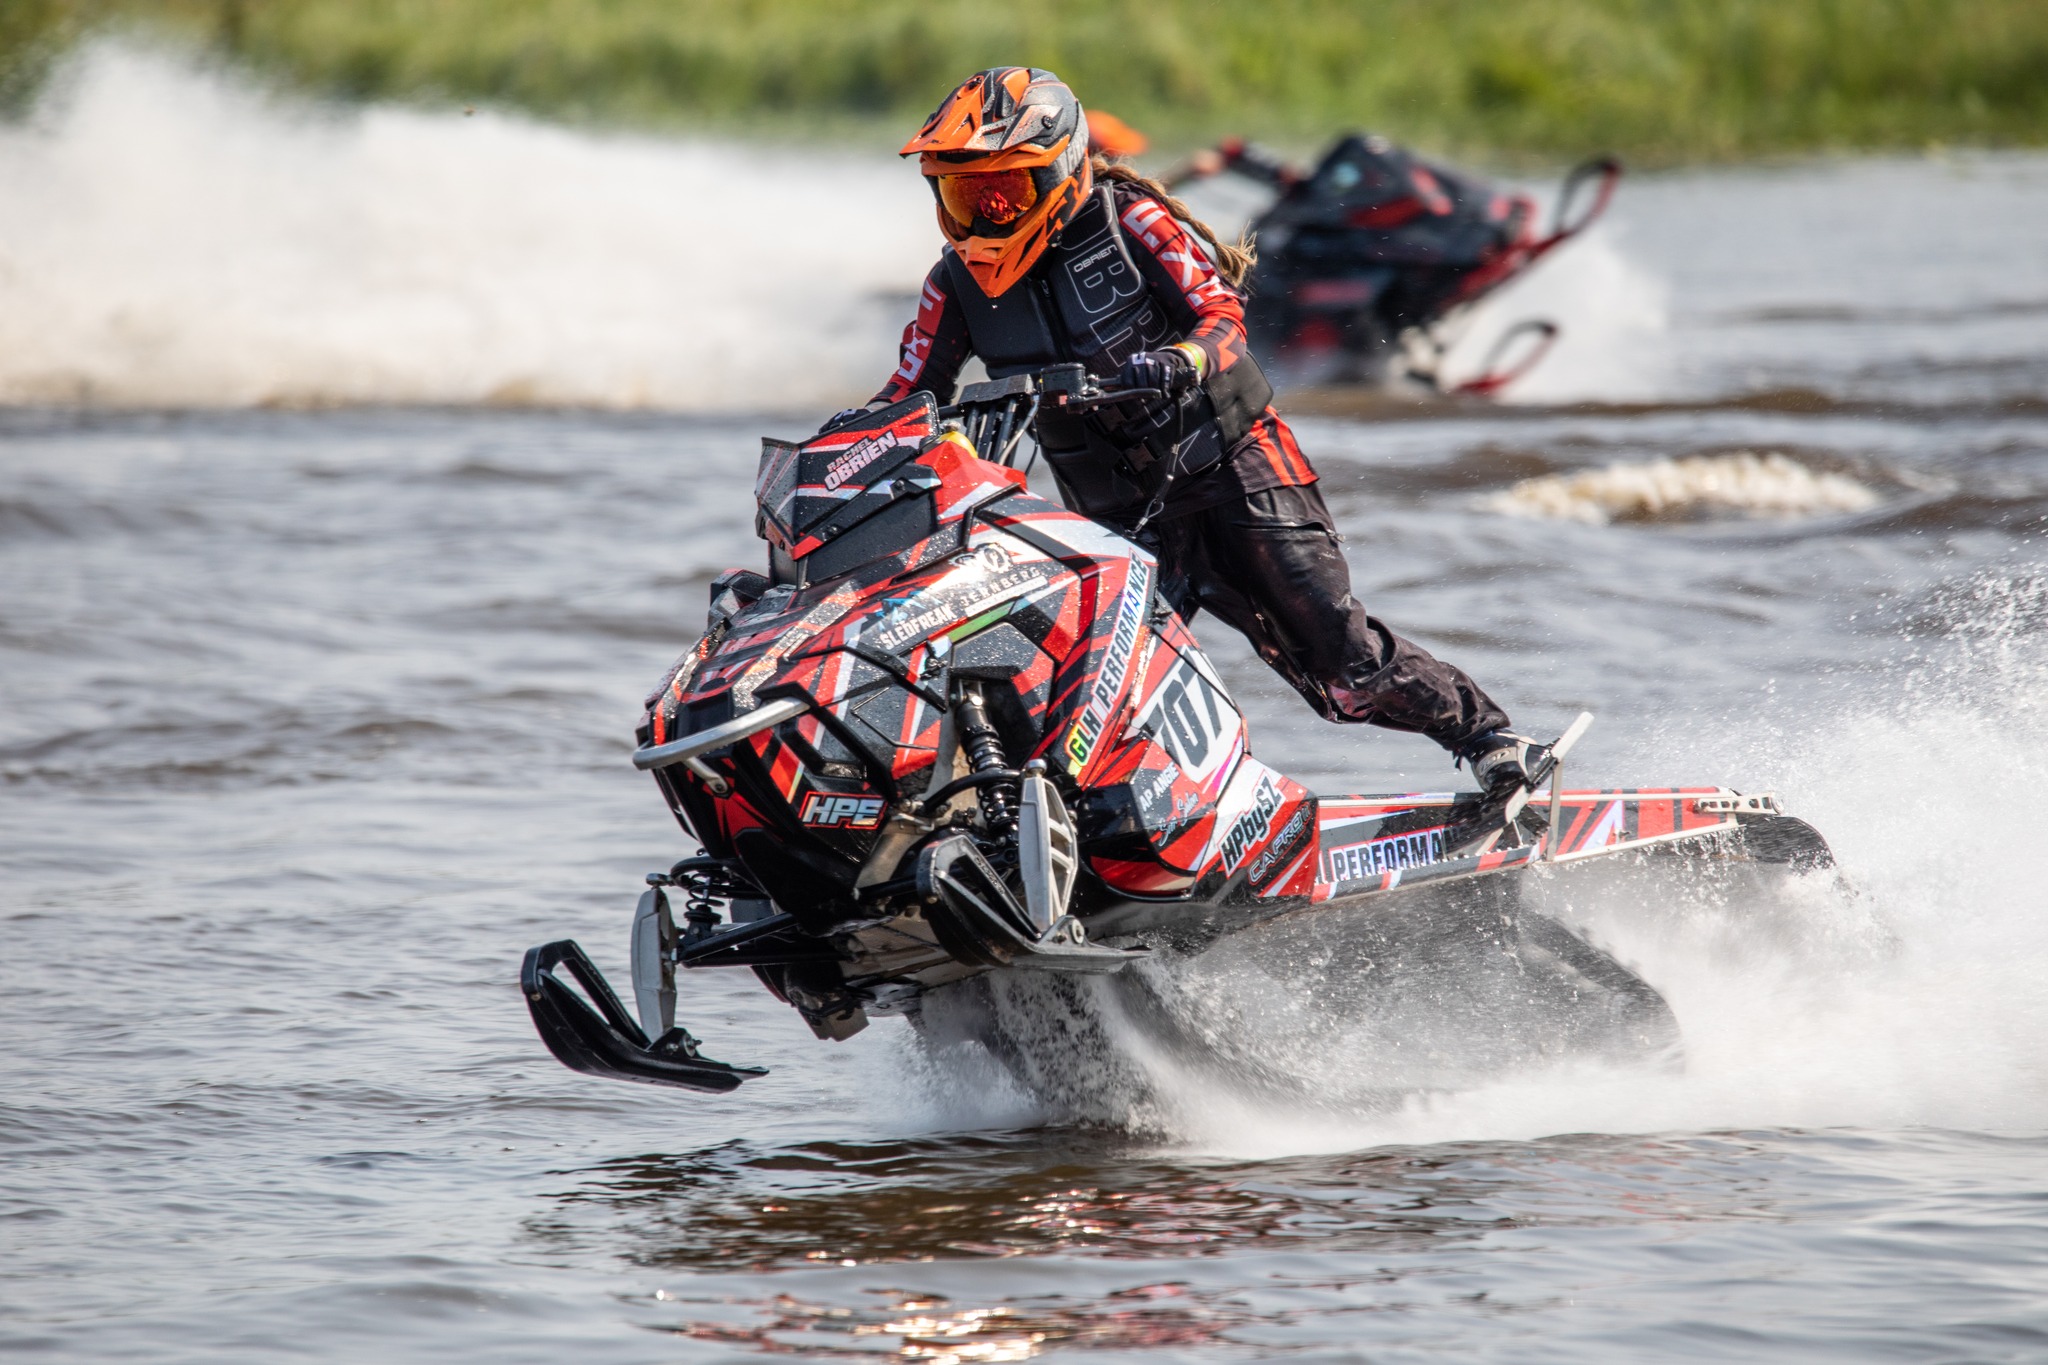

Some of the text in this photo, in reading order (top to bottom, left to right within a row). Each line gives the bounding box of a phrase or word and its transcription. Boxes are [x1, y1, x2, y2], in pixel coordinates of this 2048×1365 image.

[1073, 244, 1118, 273] OBRIEN
[824, 430, 898, 490] OBRIEN
[827, 437, 872, 473] RACHEL
[879, 604, 957, 650] SLEDFREAK
[1070, 553, 1147, 764] GLH PERFORMANCE
[1145, 648, 1223, 768] 707
[1221, 776, 1282, 874] HPbySZ
[1332, 826, 1462, 883] PERFORMA
